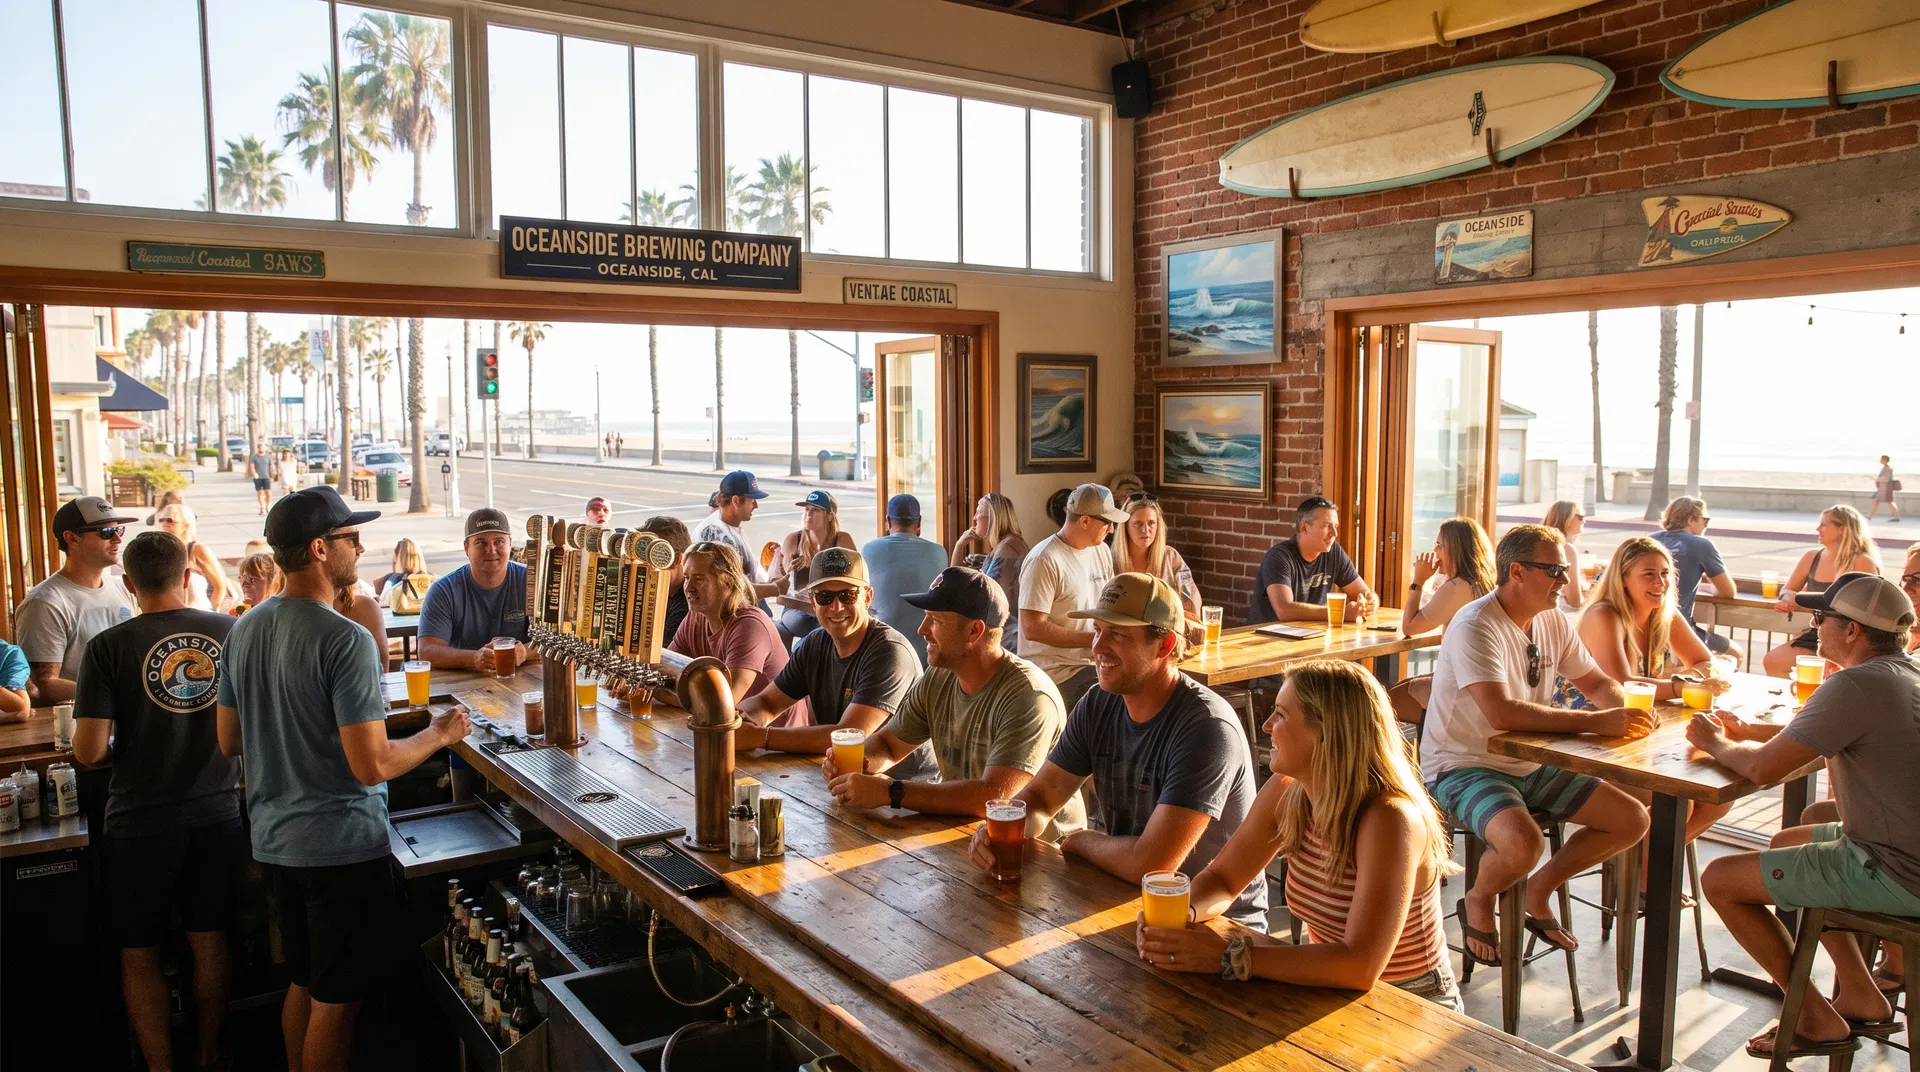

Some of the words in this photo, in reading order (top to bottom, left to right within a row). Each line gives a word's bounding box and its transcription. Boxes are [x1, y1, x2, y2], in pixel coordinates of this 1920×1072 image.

[1465, 214, 1525, 233] OCEANSIDE
[511, 226, 619, 257] OCEANSIDE
[624, 234, 706, 262] BREWING
[711, 239, 792, 268] COMPANY
[197, 250, 252, 269] Coasted
[597, 262, 686, 282] OCEANSIDE,
[690, 268, 719, 281] CAL
[901, 286, 953, 304] COASTAL
